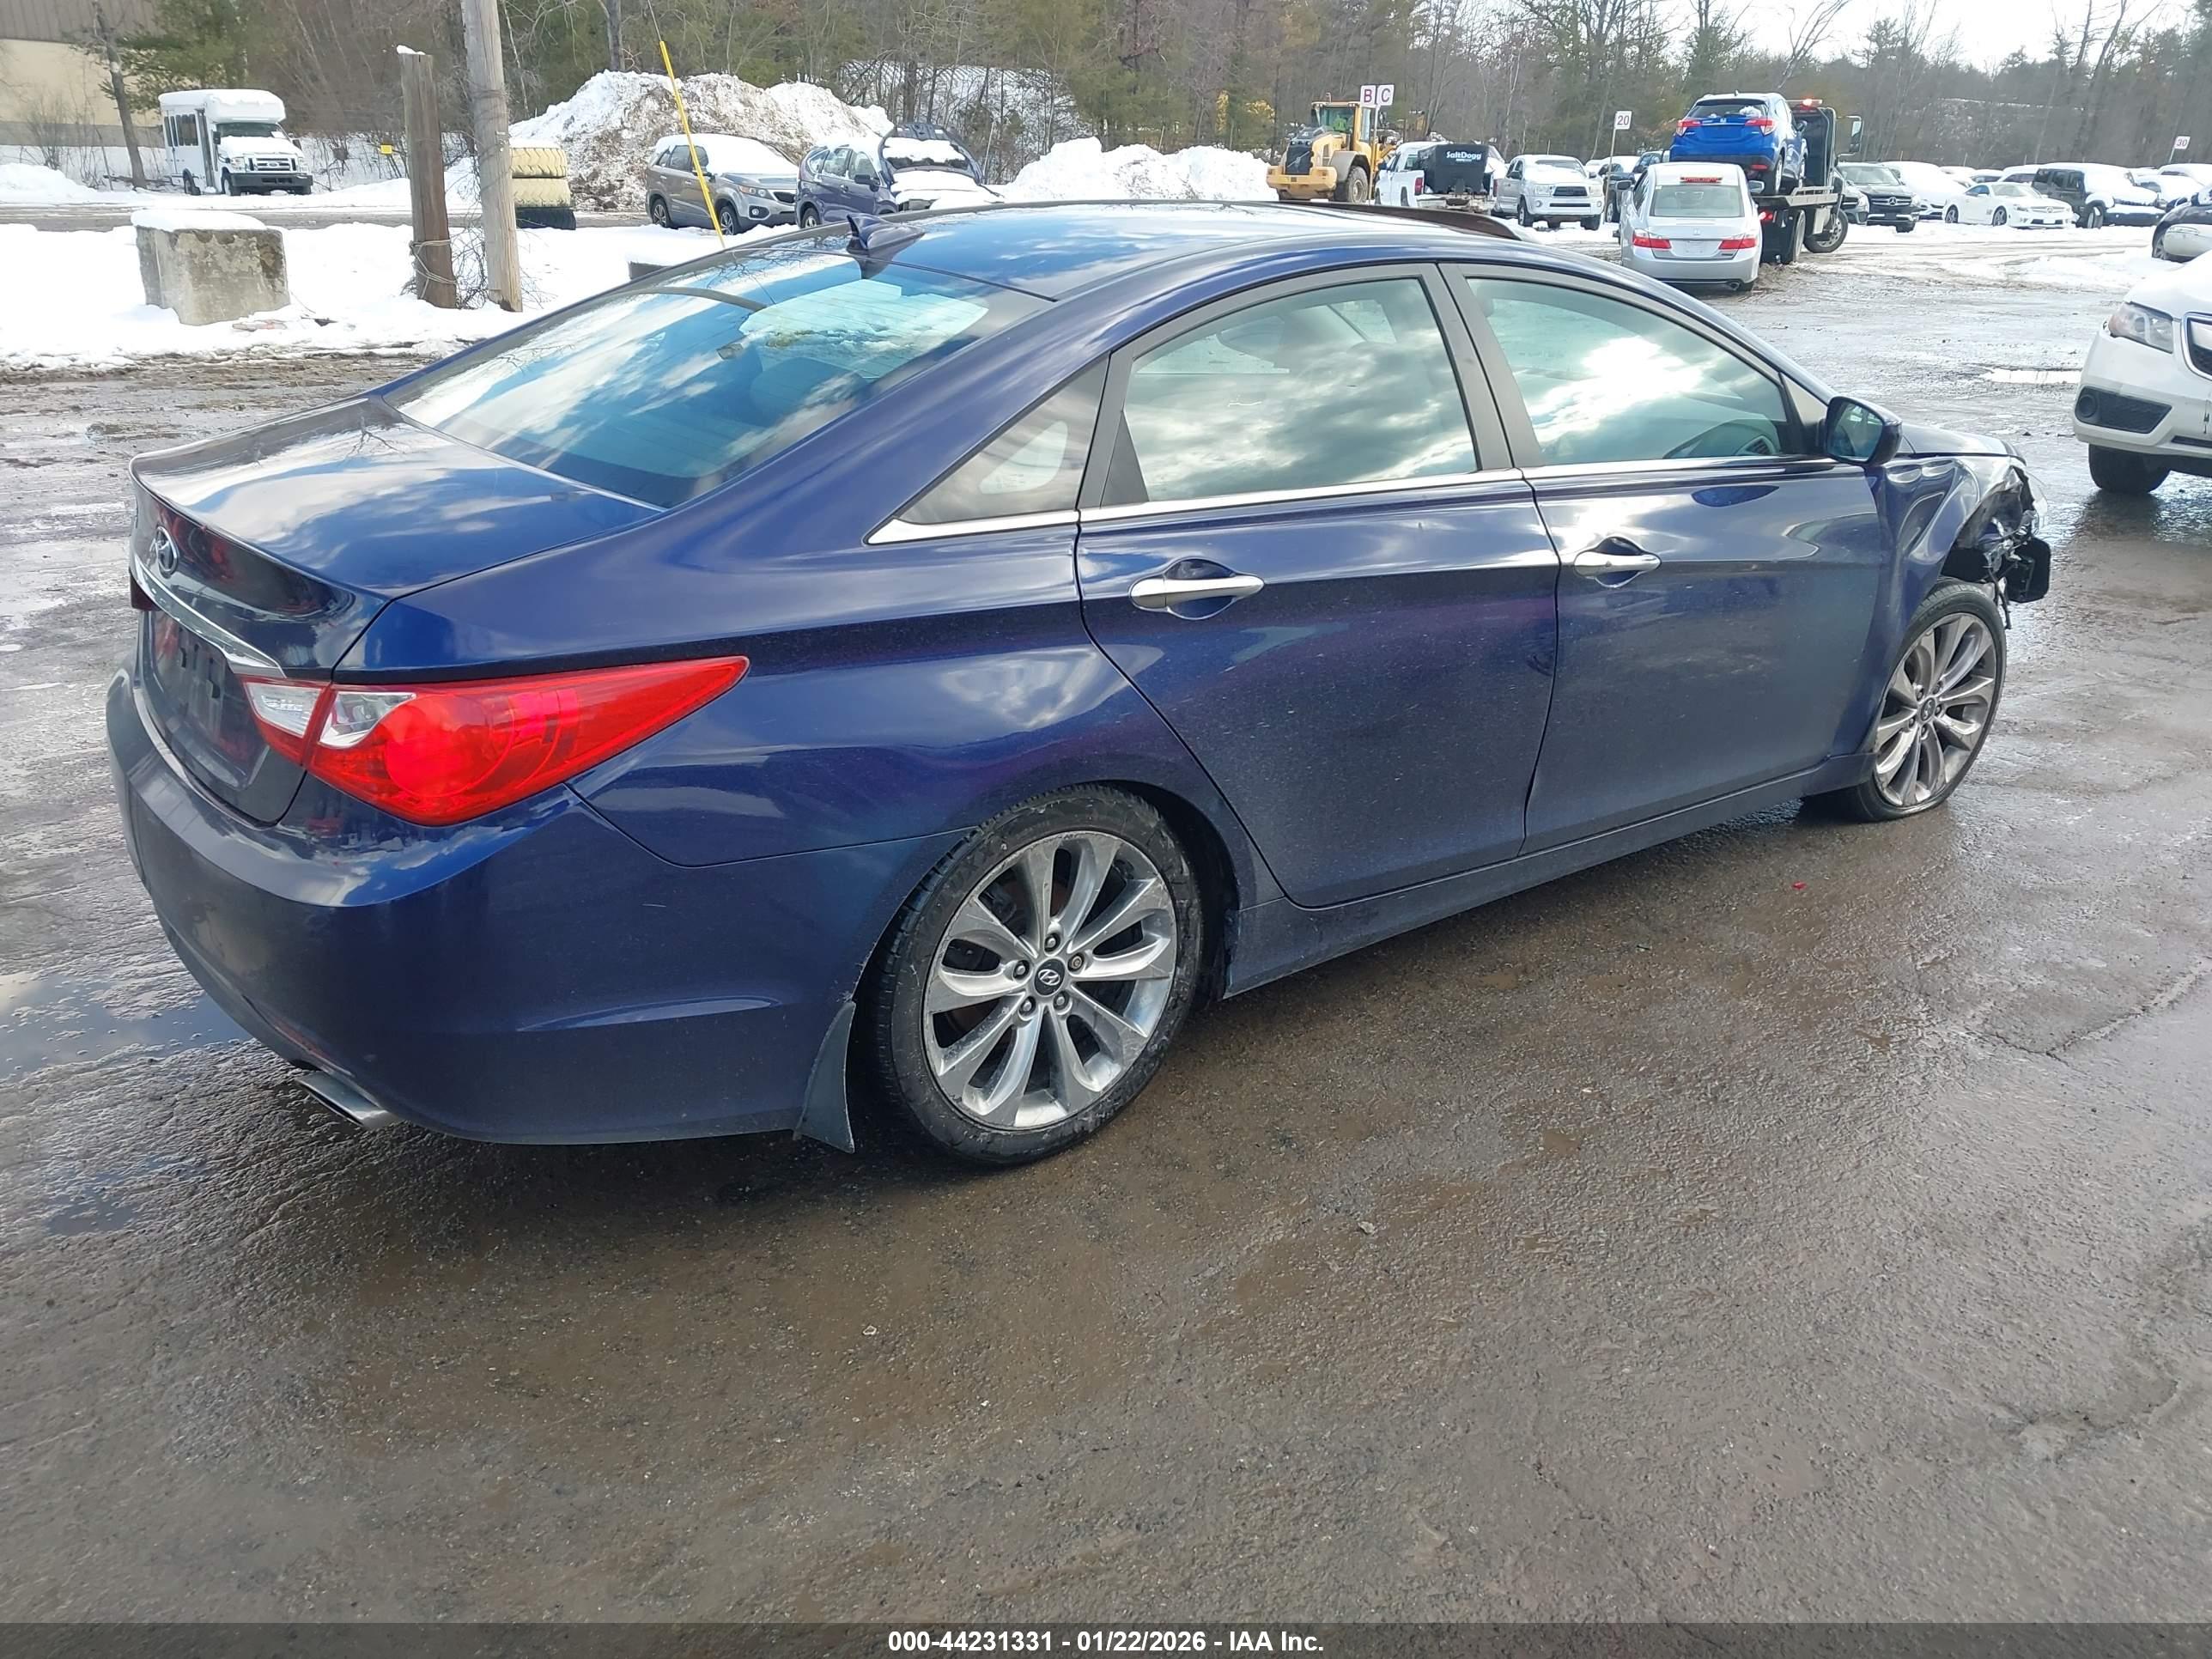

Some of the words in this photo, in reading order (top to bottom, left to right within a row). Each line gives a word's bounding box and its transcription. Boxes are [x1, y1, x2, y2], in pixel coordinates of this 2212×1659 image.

[1364, 88, 1372, 102] B
[1381, 88, 1390, 102] C
[1617, 115, 1630, 125] 20
[2176, 138, 2188, 147] 30
[1446, 150, 1482, 160] SaltDogg
